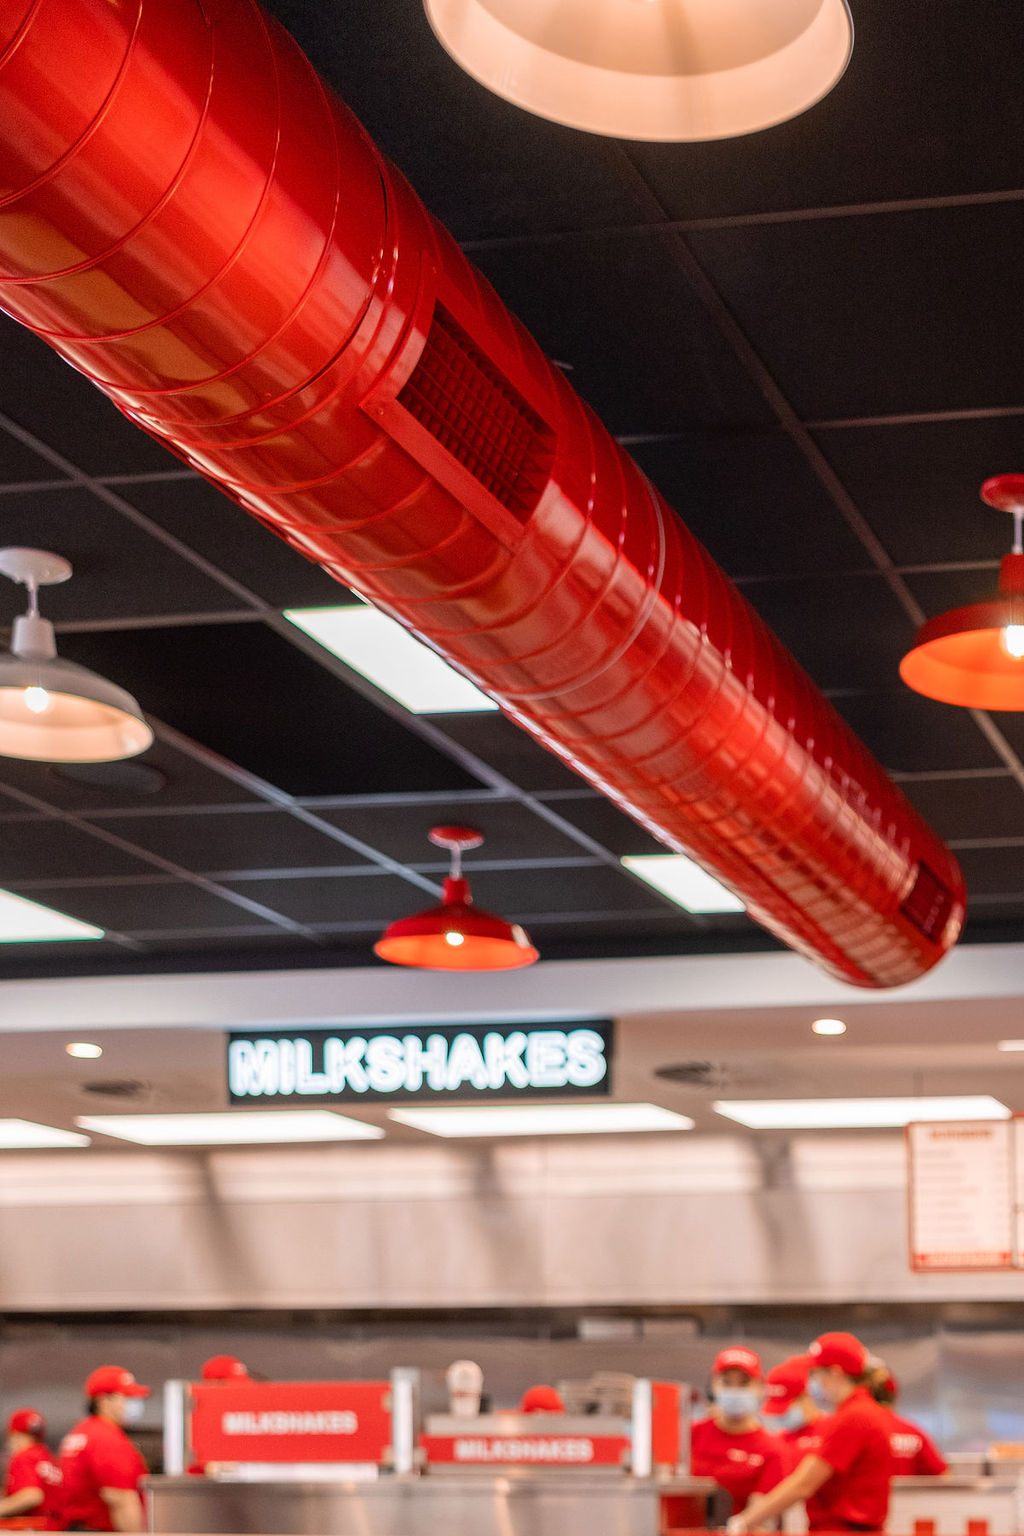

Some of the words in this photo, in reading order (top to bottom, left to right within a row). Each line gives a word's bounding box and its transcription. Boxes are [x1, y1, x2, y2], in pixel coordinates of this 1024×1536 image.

[229, 1029, 607, 1096] MILKSHAKES
[222, 1411, 358, 1436] MILKSHAKES
[454, 1438, 595, 1462] MILKSHAKES
